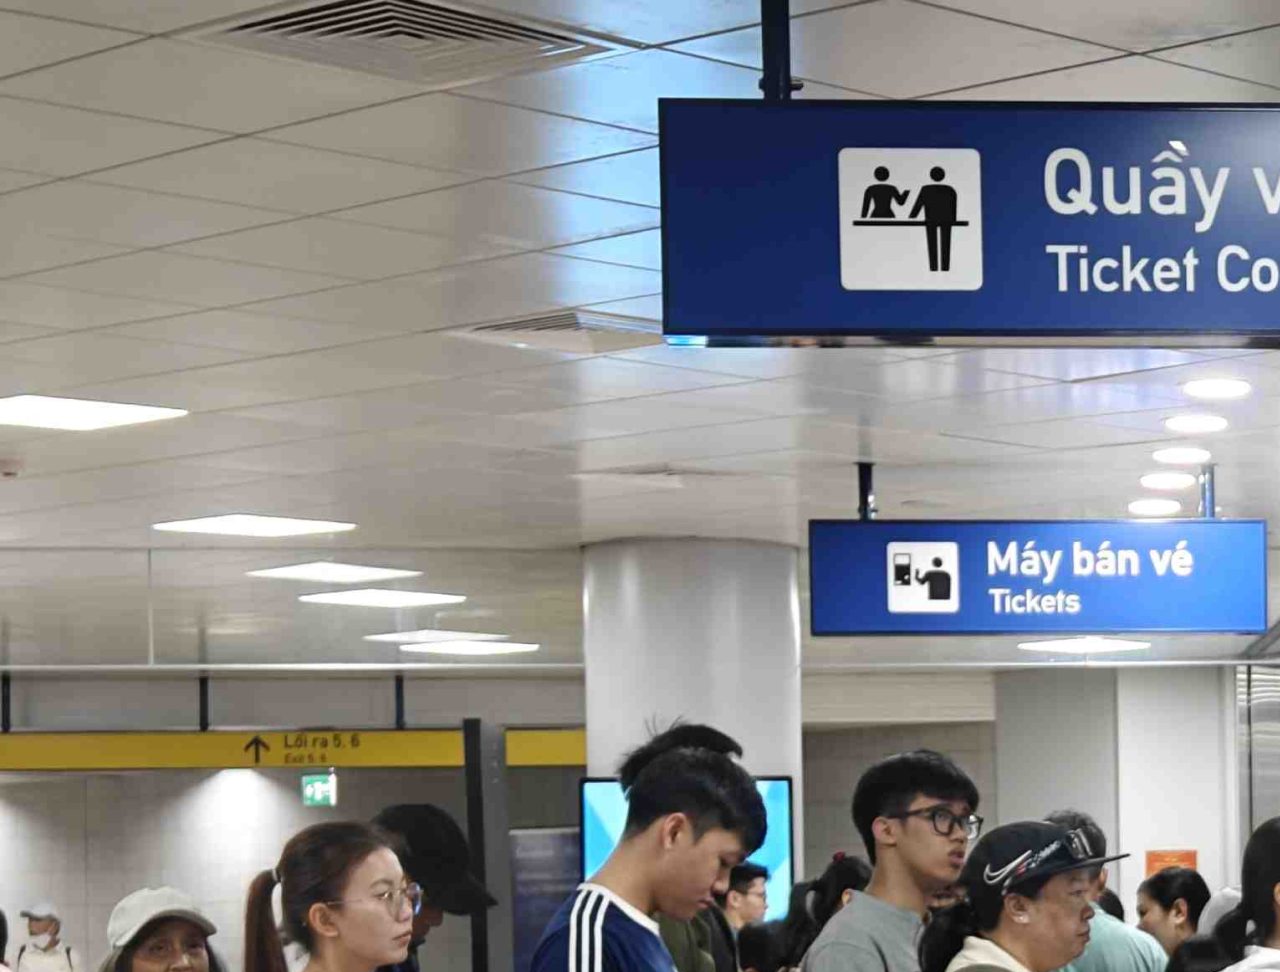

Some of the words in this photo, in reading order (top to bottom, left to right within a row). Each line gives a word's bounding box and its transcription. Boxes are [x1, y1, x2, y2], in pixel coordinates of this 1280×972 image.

[1043, 140, 1232, 234] Quầy
[1045, 244, 1198, 293] Ticket
[986, 540, 1063, 584] Máy
[1072, 540, 1140, 576] bán
[1149, 539, 1194, 576] vé
[989, 588, 1081, 614] Tickets
